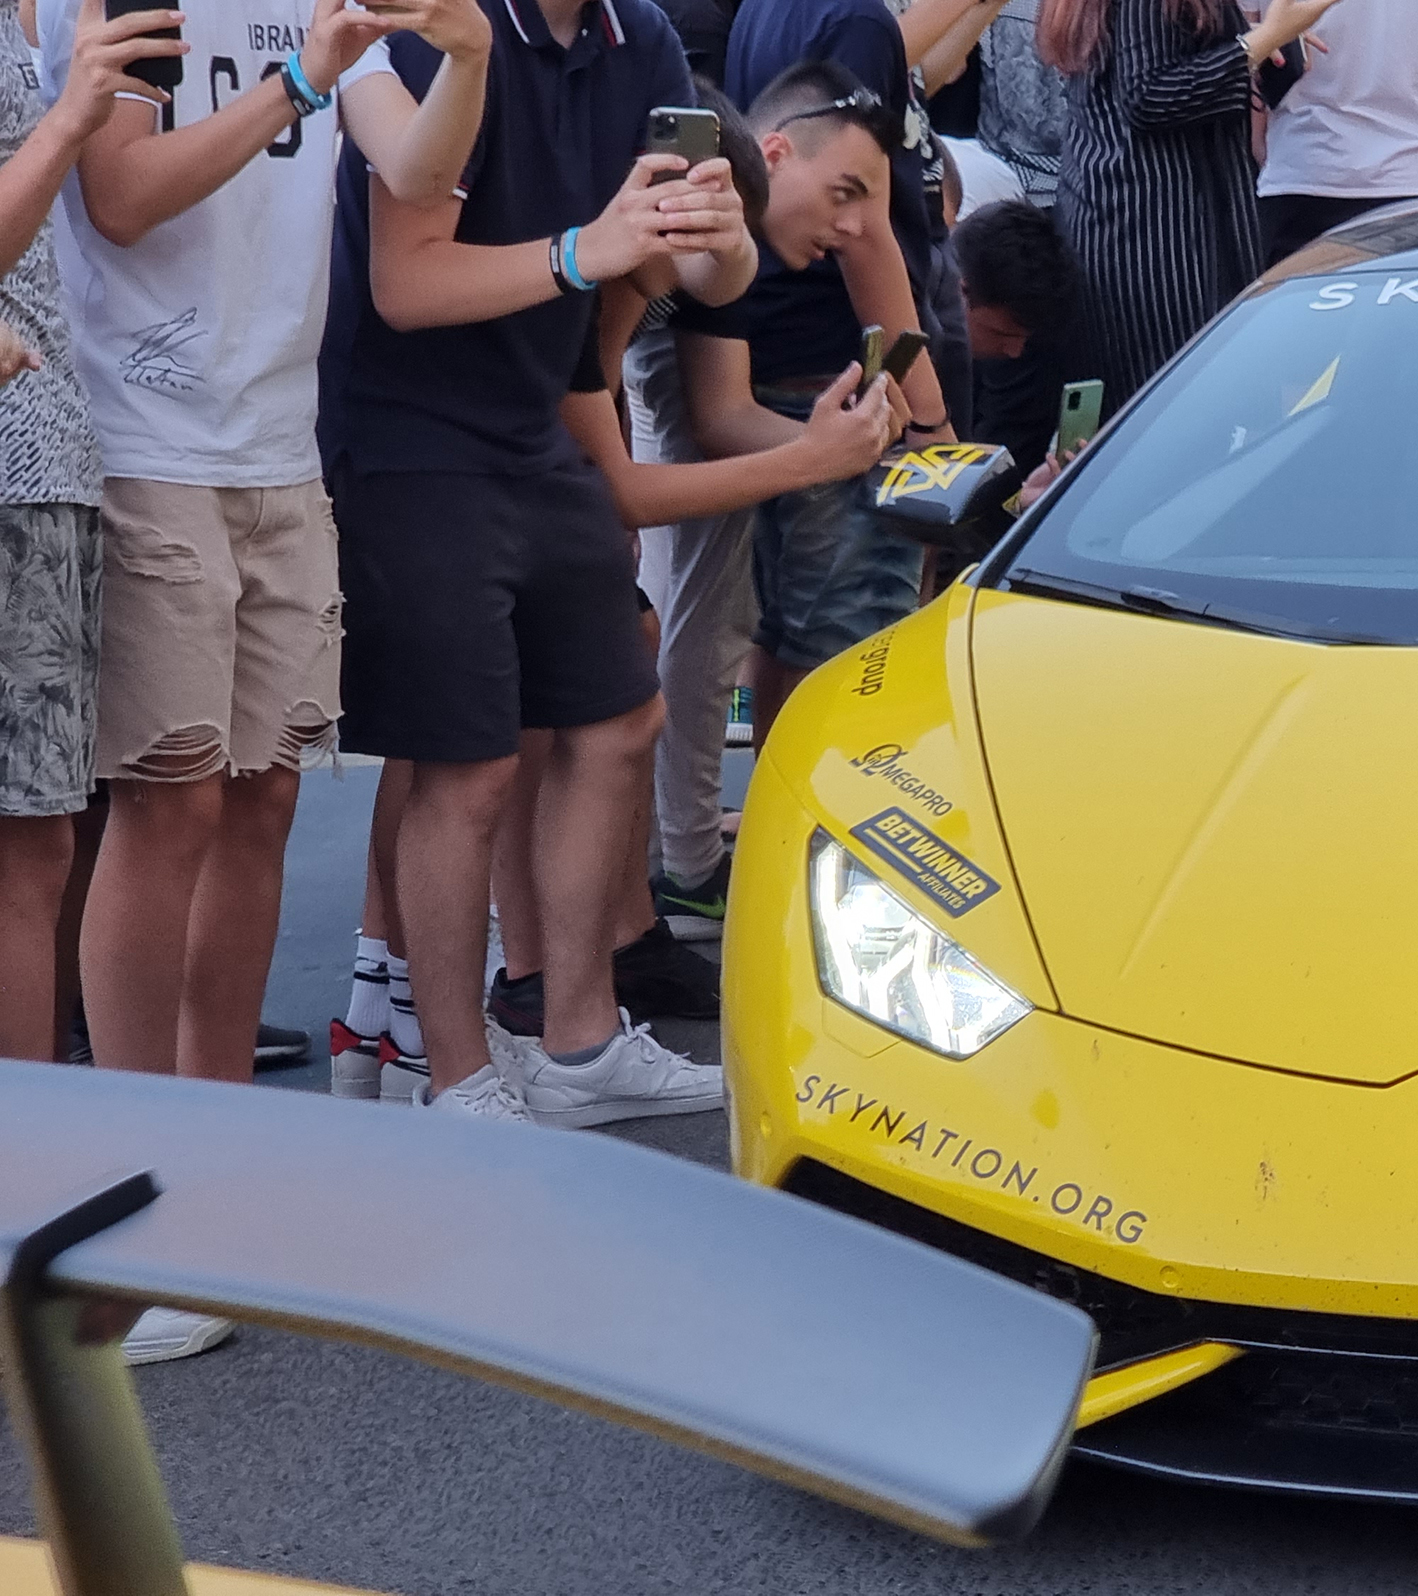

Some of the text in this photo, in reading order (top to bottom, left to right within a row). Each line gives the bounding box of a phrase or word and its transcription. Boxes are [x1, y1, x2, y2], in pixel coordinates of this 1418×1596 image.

[873, 812, 988, 900] BETWINNER
[917, 870, 967, 910] AFFILIATES
[795, 1074, 1148, 1245] SKYNATION.ORG
